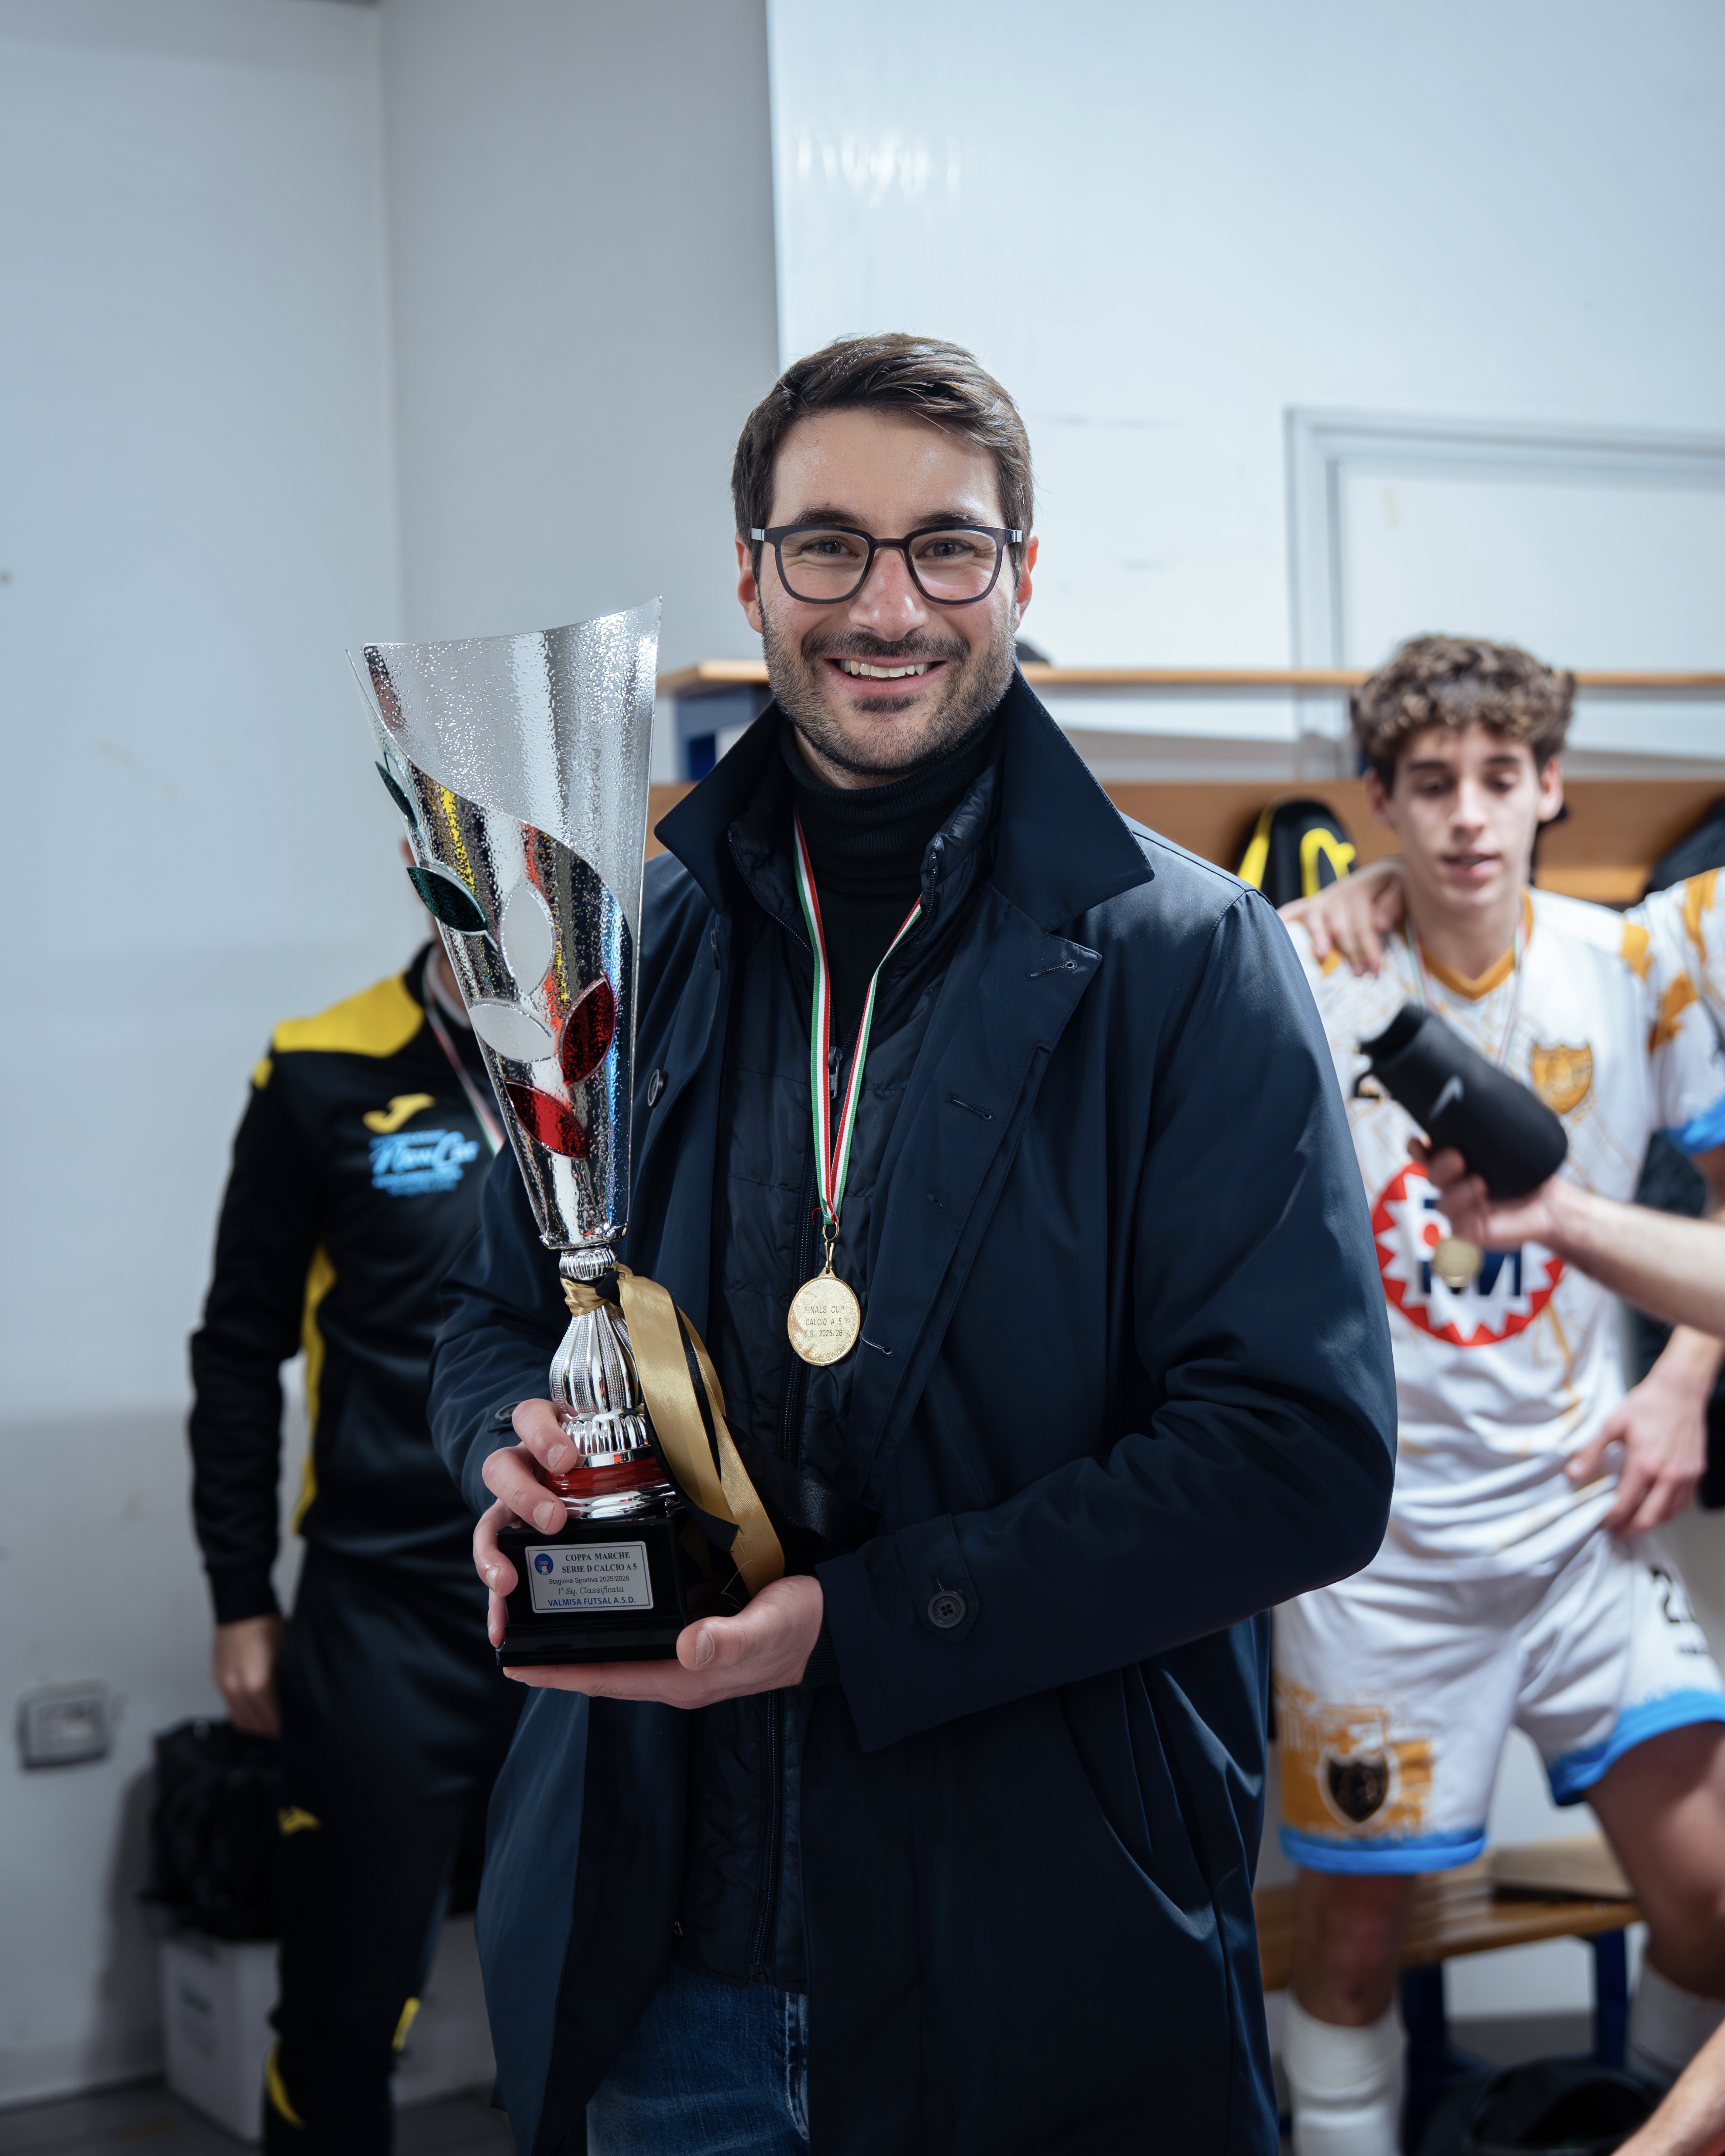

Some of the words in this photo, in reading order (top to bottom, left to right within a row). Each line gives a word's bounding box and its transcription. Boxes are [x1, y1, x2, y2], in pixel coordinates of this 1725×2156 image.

[595, 1552, 630, 1560] MARCHE
[566, 1587, 577, 1596] Sq.
[579, 1586, 624, 1594] Classificata
[548, 1598, 582, 1606] VALMISA
